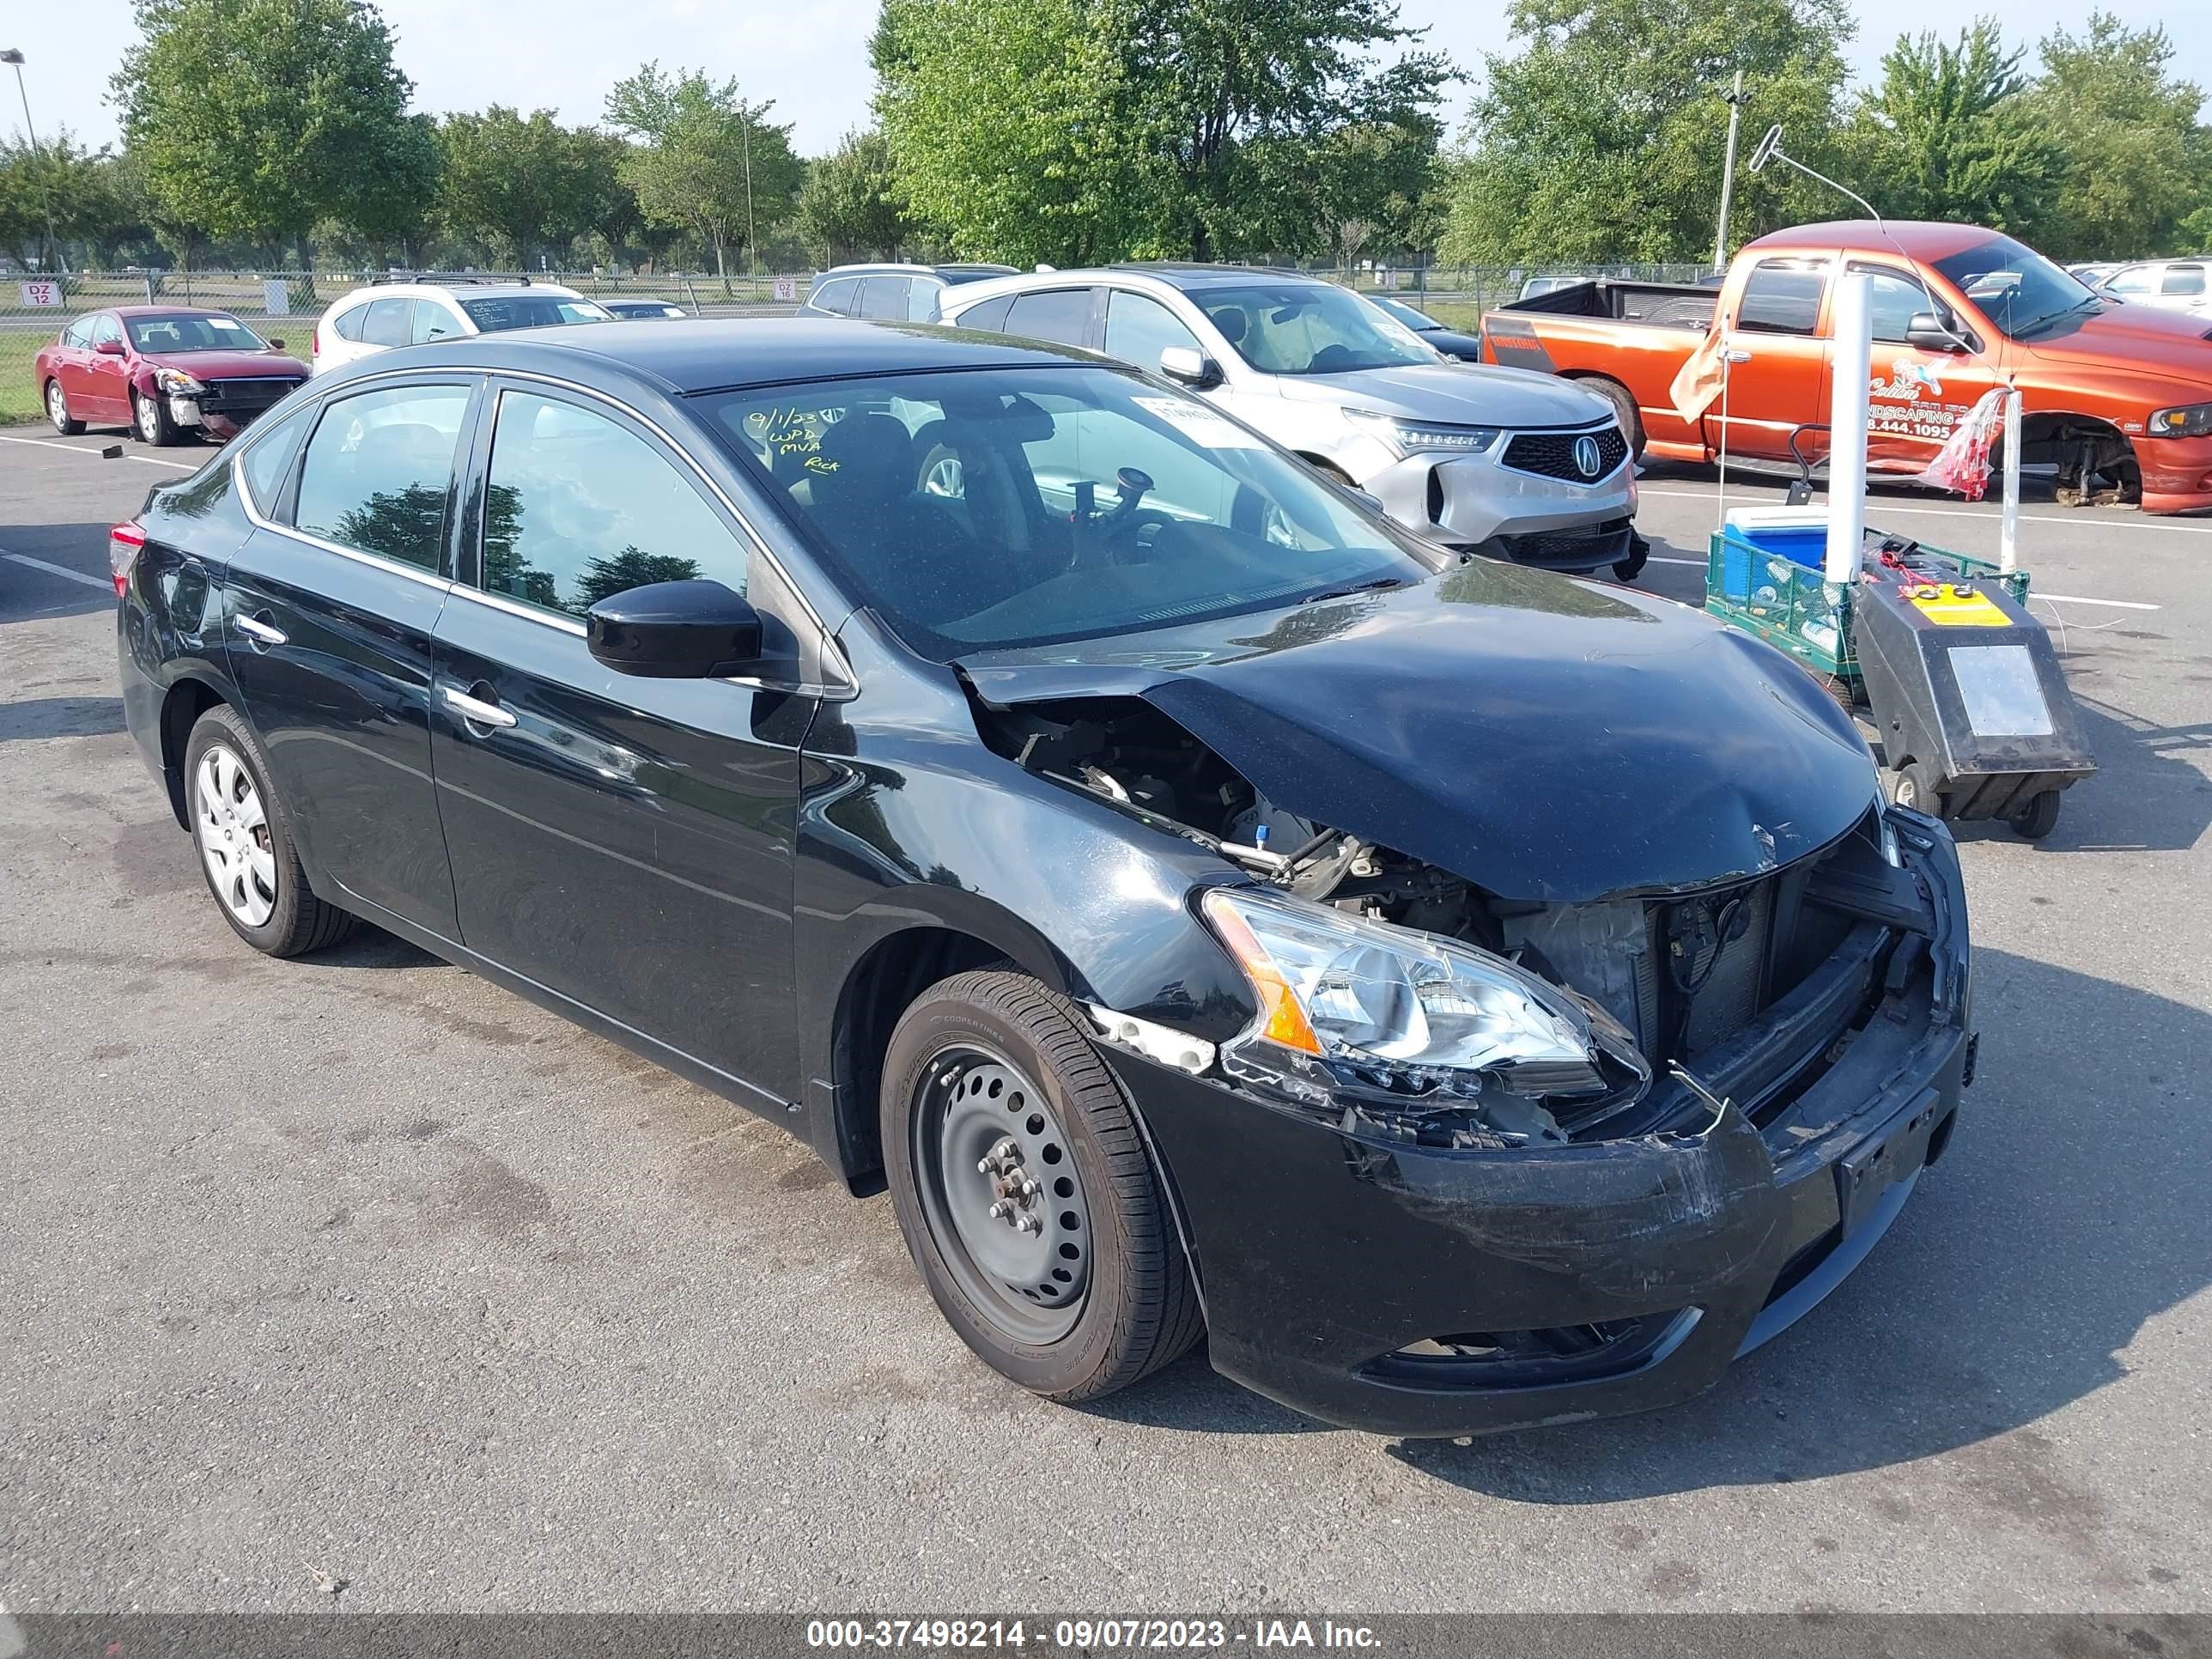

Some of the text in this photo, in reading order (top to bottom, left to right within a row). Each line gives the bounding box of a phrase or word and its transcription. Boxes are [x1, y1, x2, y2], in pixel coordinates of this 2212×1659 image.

[28, 285, 51, 295] DZ
[33, 295, 51, 304] 12
[749, 407, 818, 430] 9/1/23
[769, 429, 815, 441] WPD
